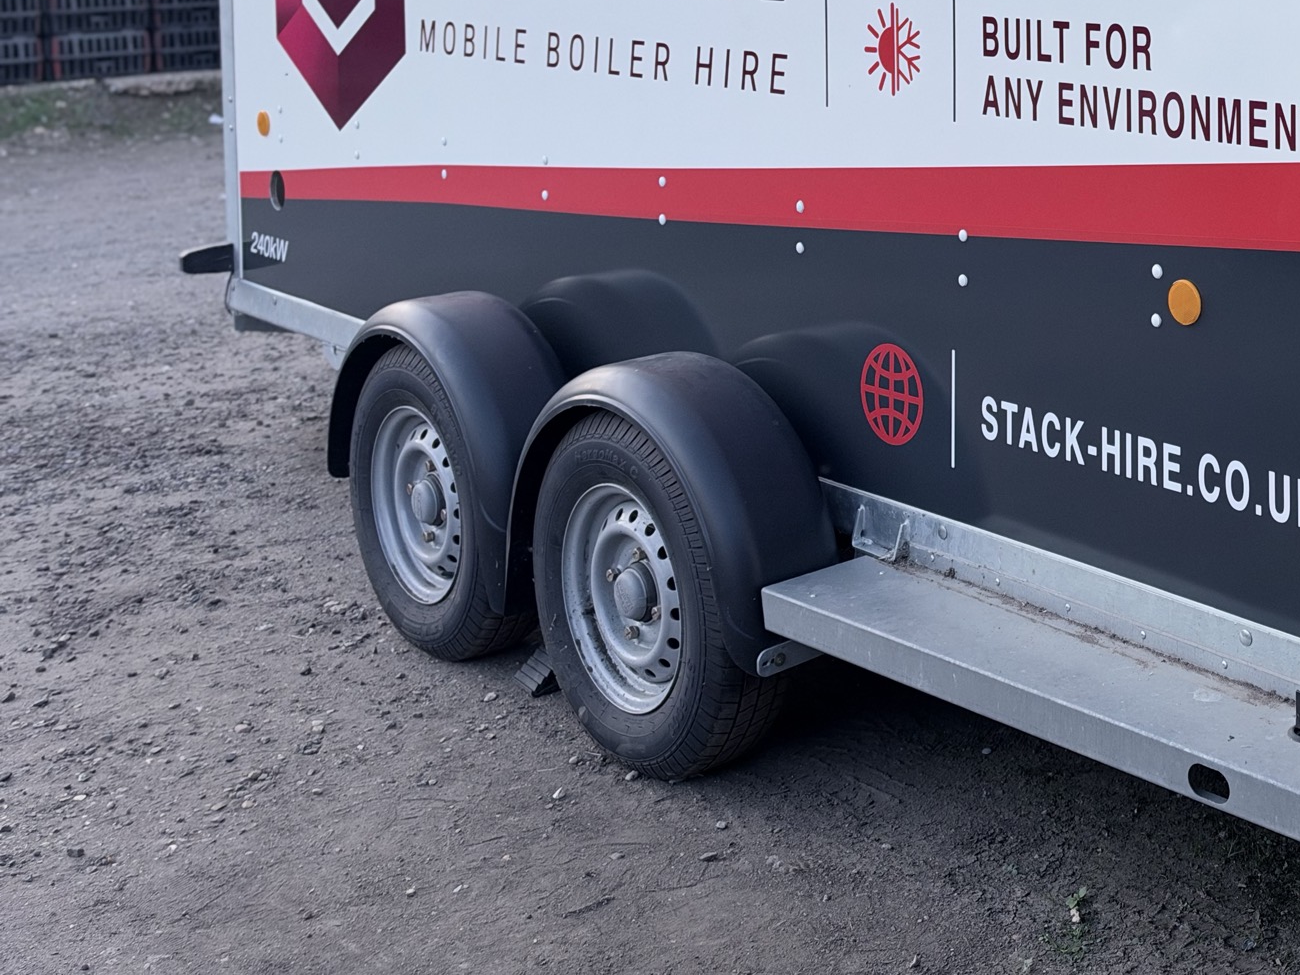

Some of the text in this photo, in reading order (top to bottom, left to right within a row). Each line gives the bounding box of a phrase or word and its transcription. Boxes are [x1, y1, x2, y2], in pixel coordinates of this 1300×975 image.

[419, 19, 788, 96] MOBILE BOILER HIRE
[981, 15, 1152, 71] BUILT FOR
[982, 75, 1043, 121] ANY
[250, 231, 289, 263] 240kW
